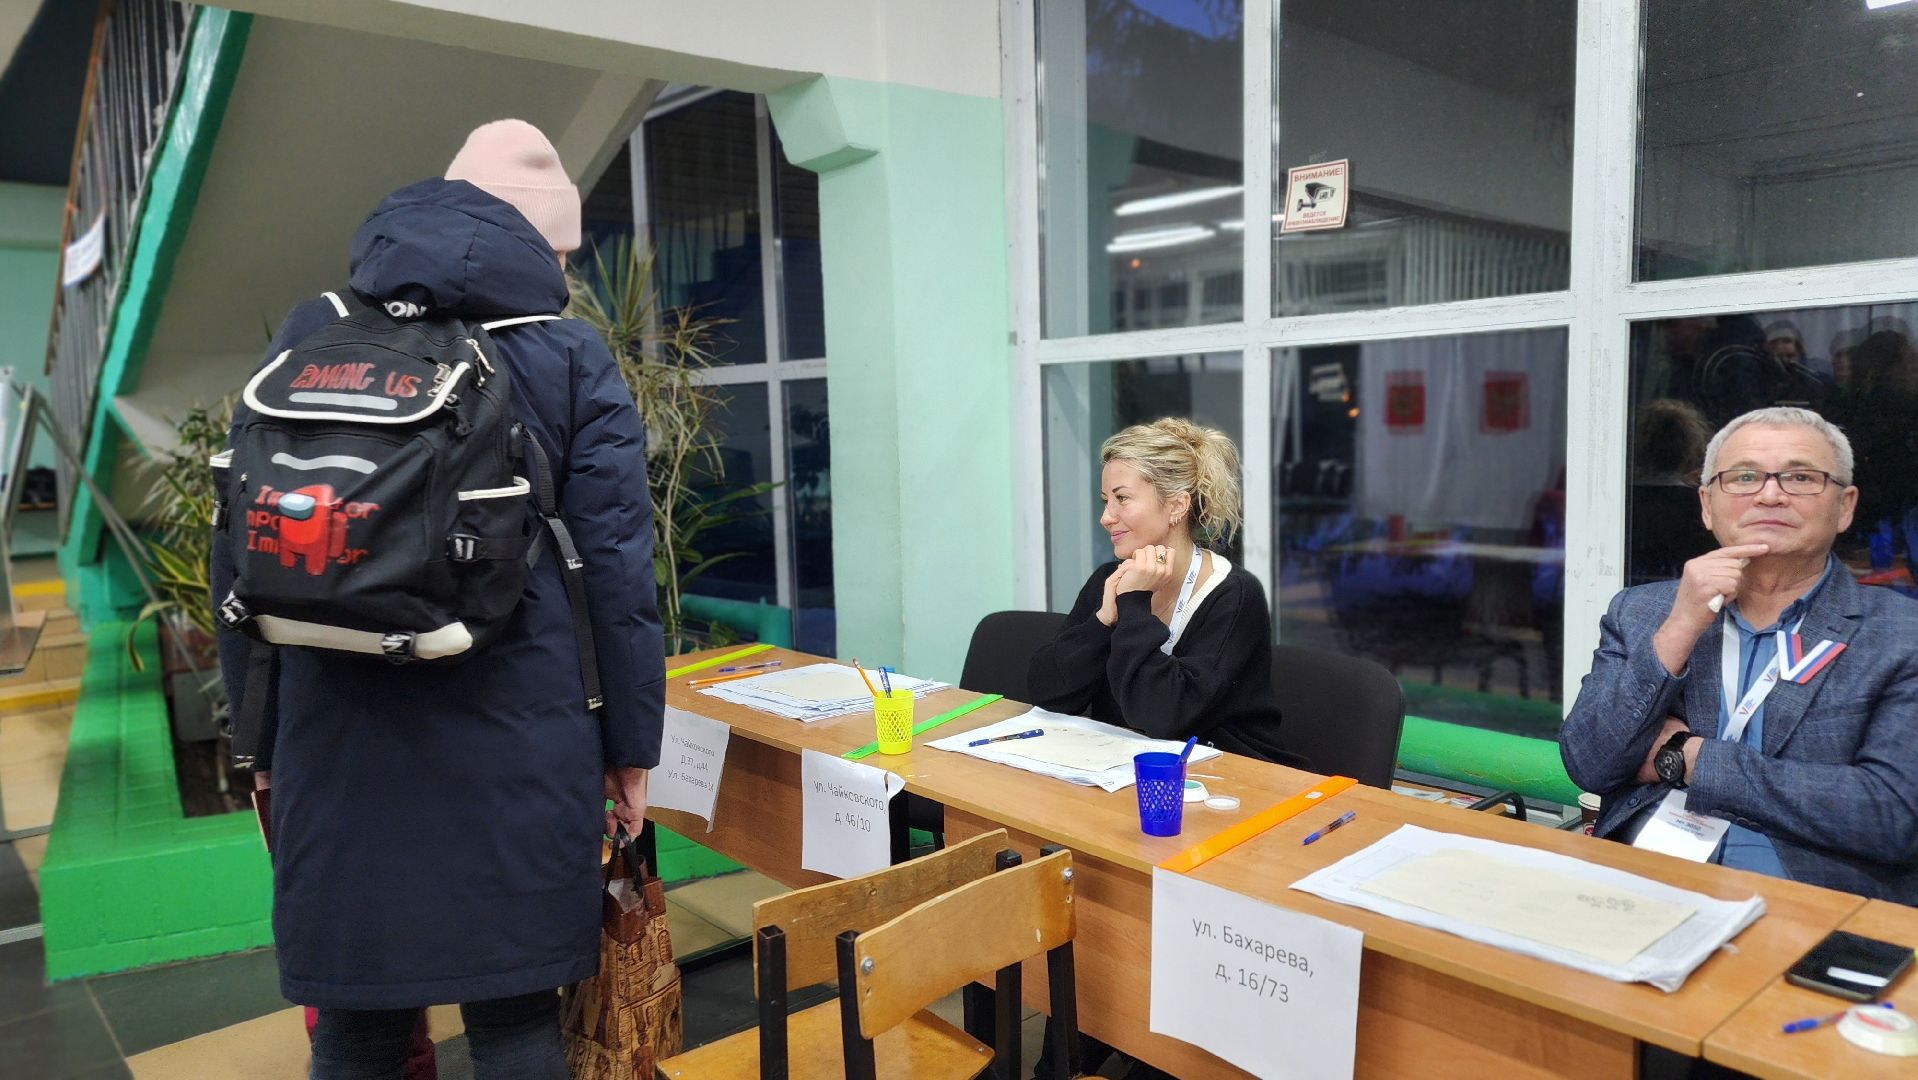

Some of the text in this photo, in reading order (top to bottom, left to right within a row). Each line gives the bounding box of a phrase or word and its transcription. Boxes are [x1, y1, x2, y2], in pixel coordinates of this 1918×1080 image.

[1294, 167, 1344, 182] ВНИМАНИЕ!
[384, 371, 422, 398] US
[814, 780, 887, 814] ул. Чайковского,
[845, 813, 871, 832] 46/10
[1192, 918, 1315, 978] ул. Бахарева,
[1215, 963, 1289, 1003] д. 16/73
